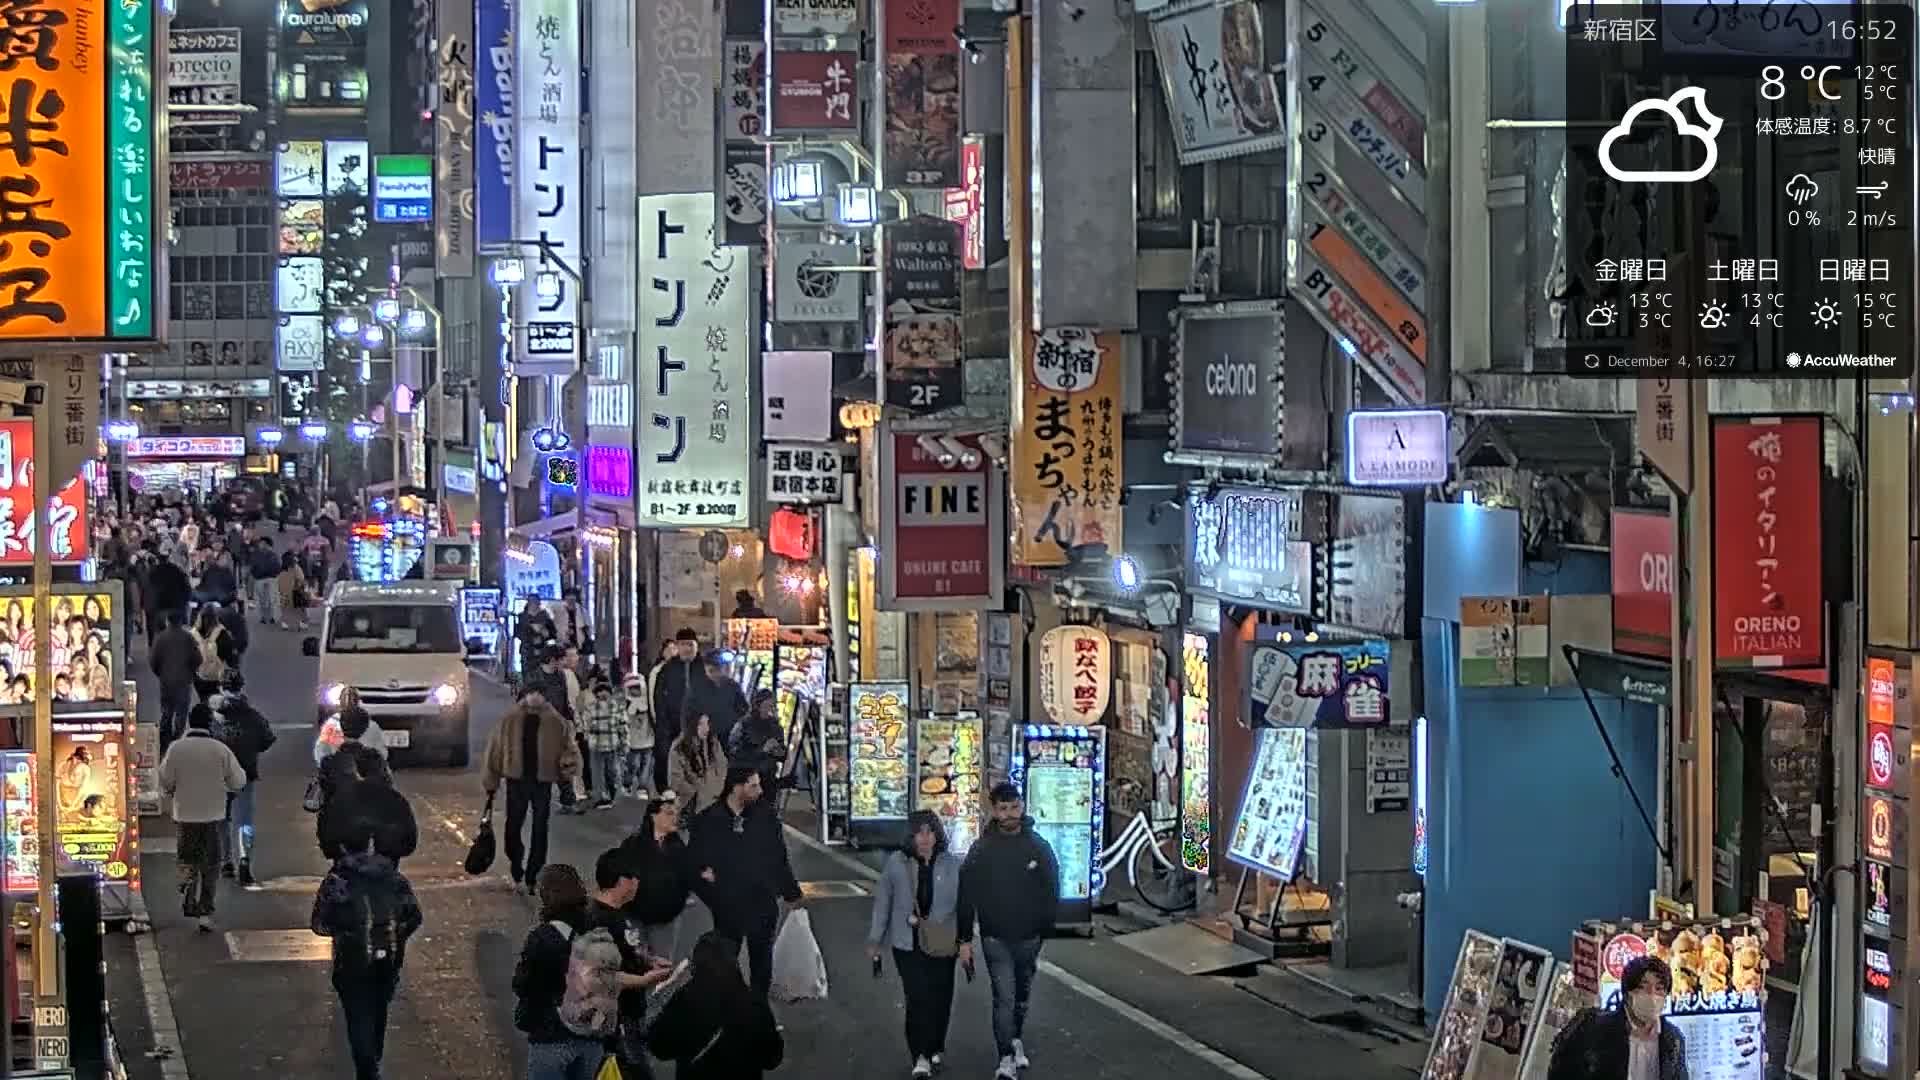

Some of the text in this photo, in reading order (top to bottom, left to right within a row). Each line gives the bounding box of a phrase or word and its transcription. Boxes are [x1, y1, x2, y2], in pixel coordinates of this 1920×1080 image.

[1307, 21, 1328, 42] 5
[823, 59, 852, 121] 牛門
[1307, 75, 1328, 92] 4
[1307, 122, 1328, 142] 3
[1306, 172, 1327, 193] 2
[894, 256, 952, 272] Walton's
[1304, 268, 1333, 300] B1
[652, 210, 686, 464] トントン
[1036, 340, 1096, 376] 新宿
[1206, 360, 1257, 397] celona
[910, 385, 940, 406] 2F
[773, 450, 837, 472] 酒場心
[773, 475, 838, 494] 新宿本店
[904, 485, 980, 514] FINE
[1747, 431, 1783, 604] 俺のイタリアン
[1734, 615, 1801, 634] ORENO
[1733, 634, 1802, 652] ITALIAN
[1674, 990, 1759, 1011] 炭火焼き鳥
[35, 1006, 66, 1026] NERO
[38, 1038, 68, 1057] NERO
